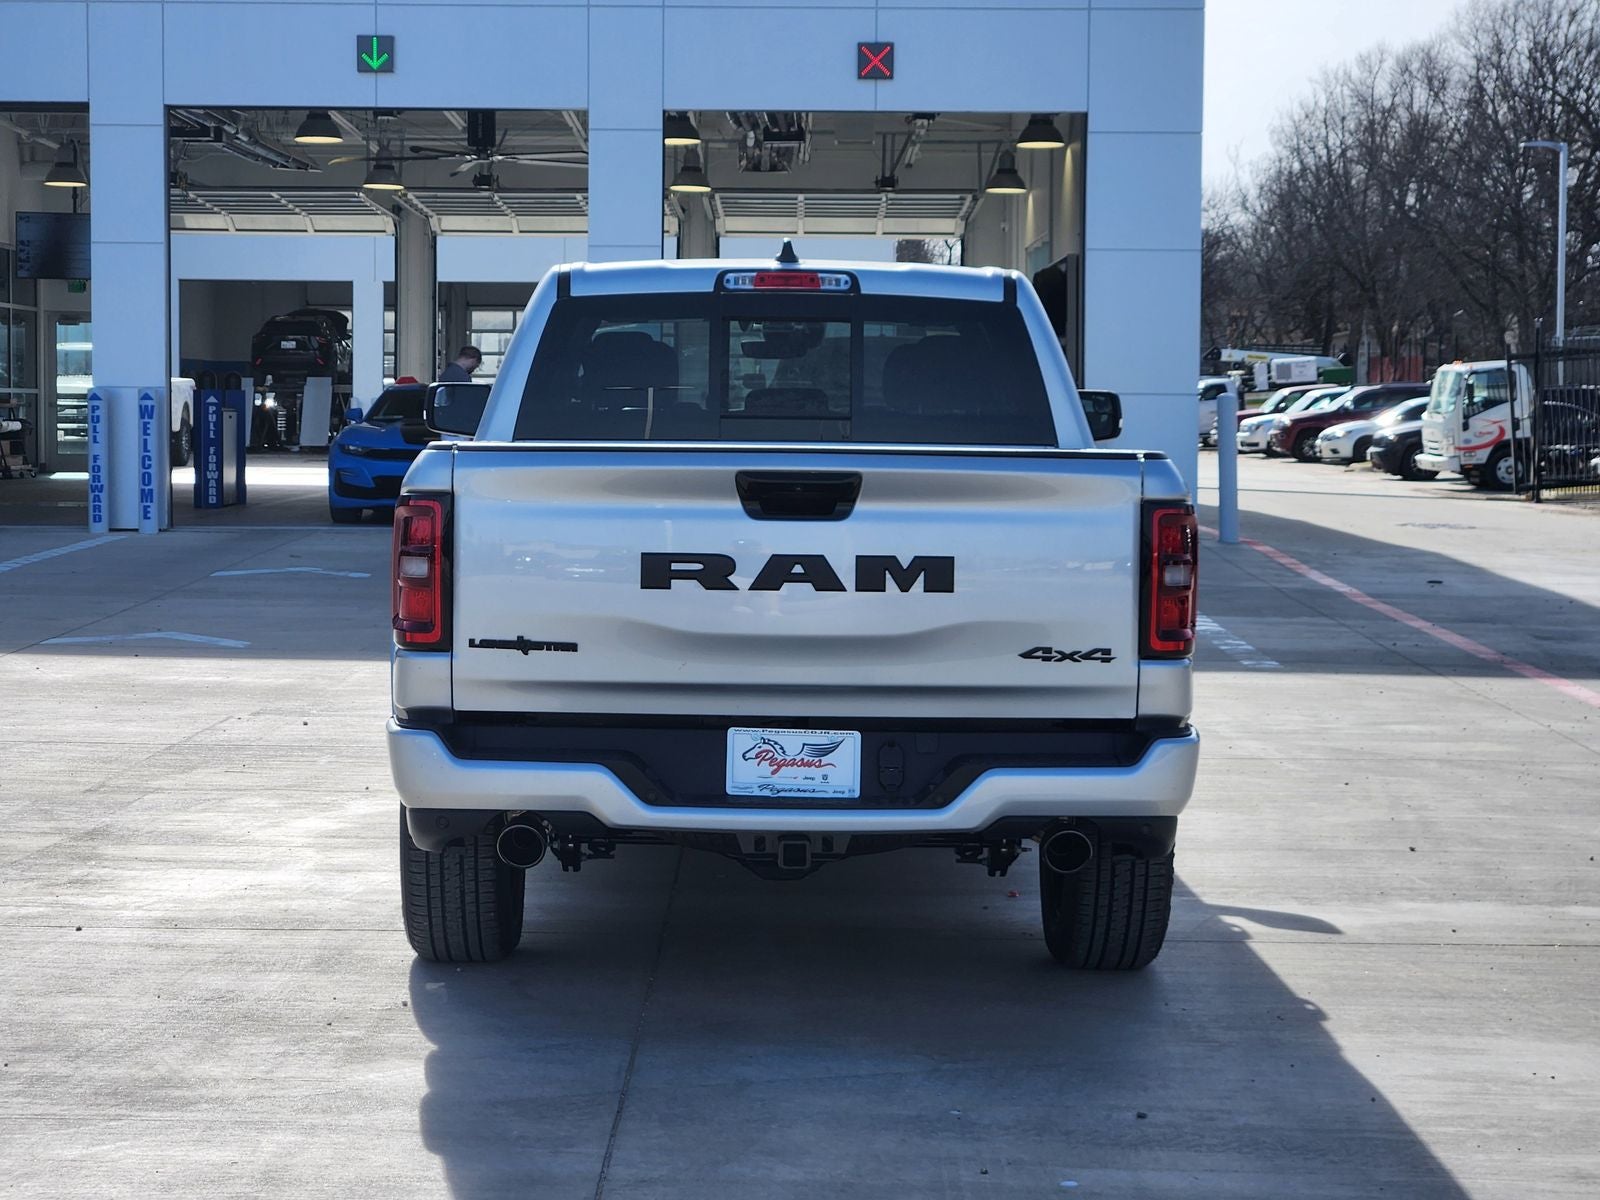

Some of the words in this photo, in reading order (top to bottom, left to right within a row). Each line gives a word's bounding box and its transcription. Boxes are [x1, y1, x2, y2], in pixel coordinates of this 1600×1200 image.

[91, 405, 100, 443] PULL
[207, 405, 216, 439] PULL
[139, 404, 155, 520] WELCOME
[206, 446, 219, 504] FORWARD
[91, 454, 104, 522] FORWARD
[640, 551, 955, 593] RAM
[755, 749, 837, 776] Pegasus
